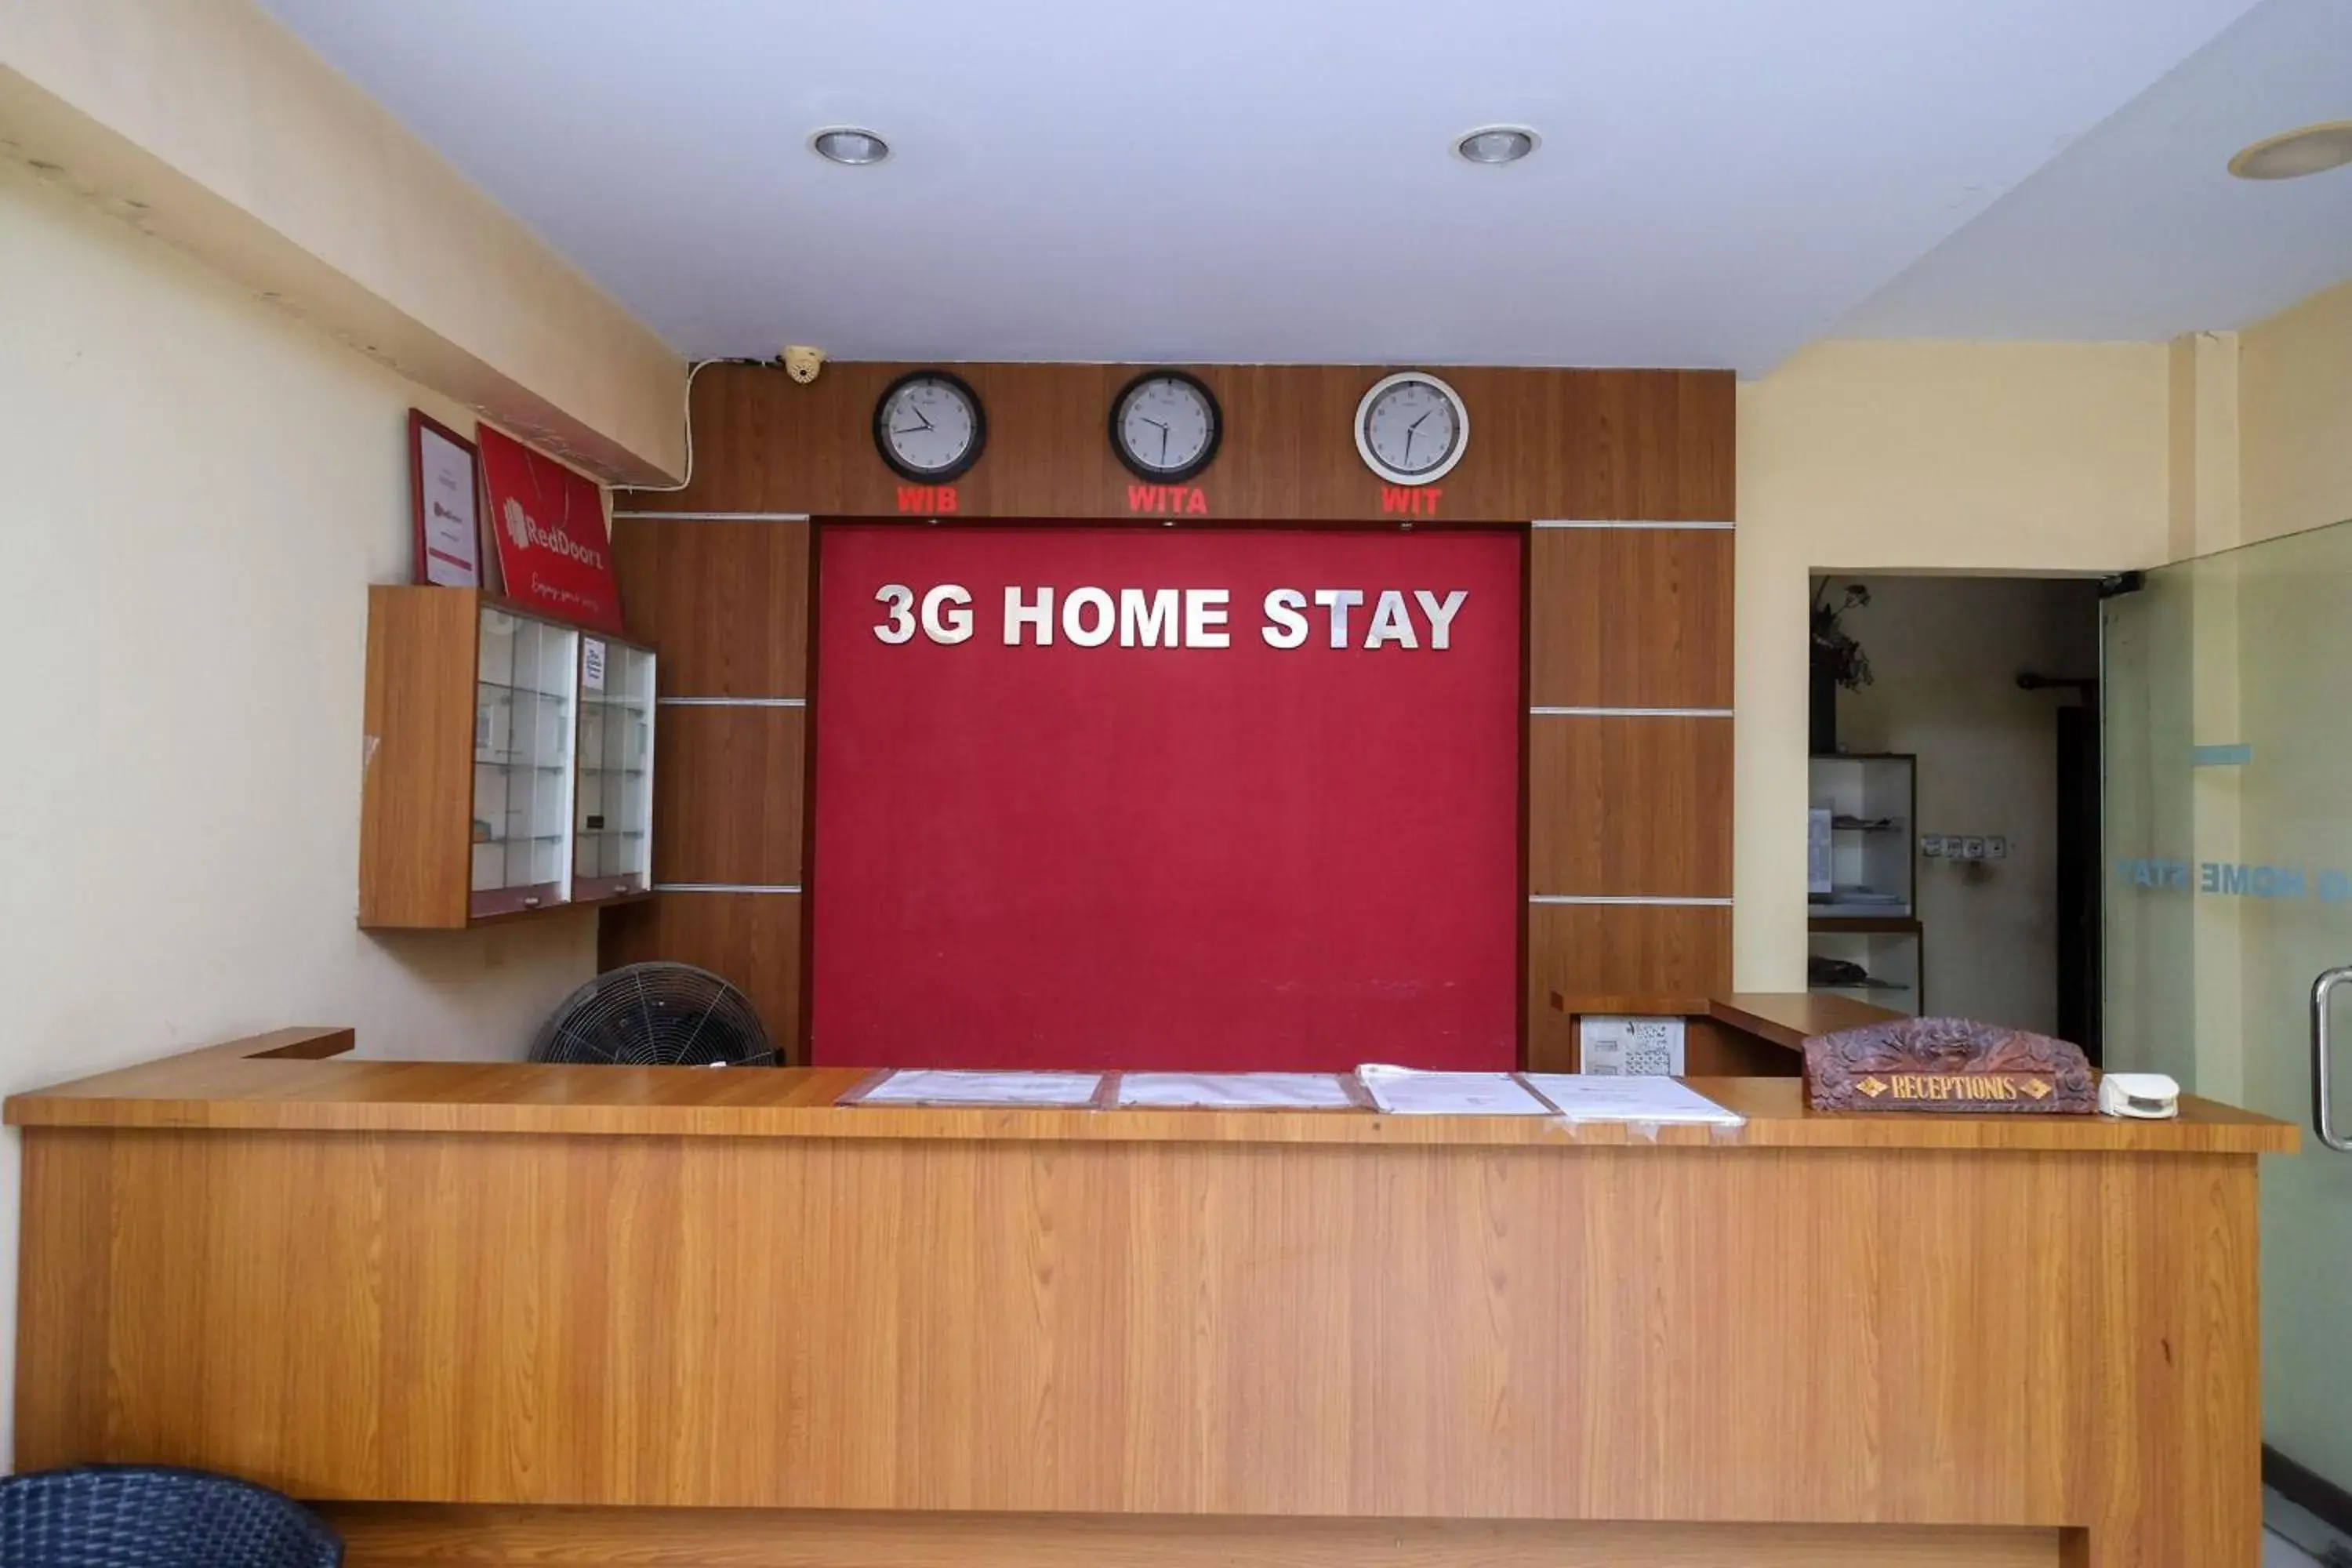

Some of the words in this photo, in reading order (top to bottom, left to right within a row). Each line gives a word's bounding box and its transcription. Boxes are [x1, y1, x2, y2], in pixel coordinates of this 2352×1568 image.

[896, 486, 956, 514] WIB
[1127, 485, 1207, 514] WITA
[1381, 487, 1442, 515] WIT
[873, 583, 975, 644] 3G
[1003, 586, 1231, 648] HOME
[1261, 587, 1468, 650] STAY
